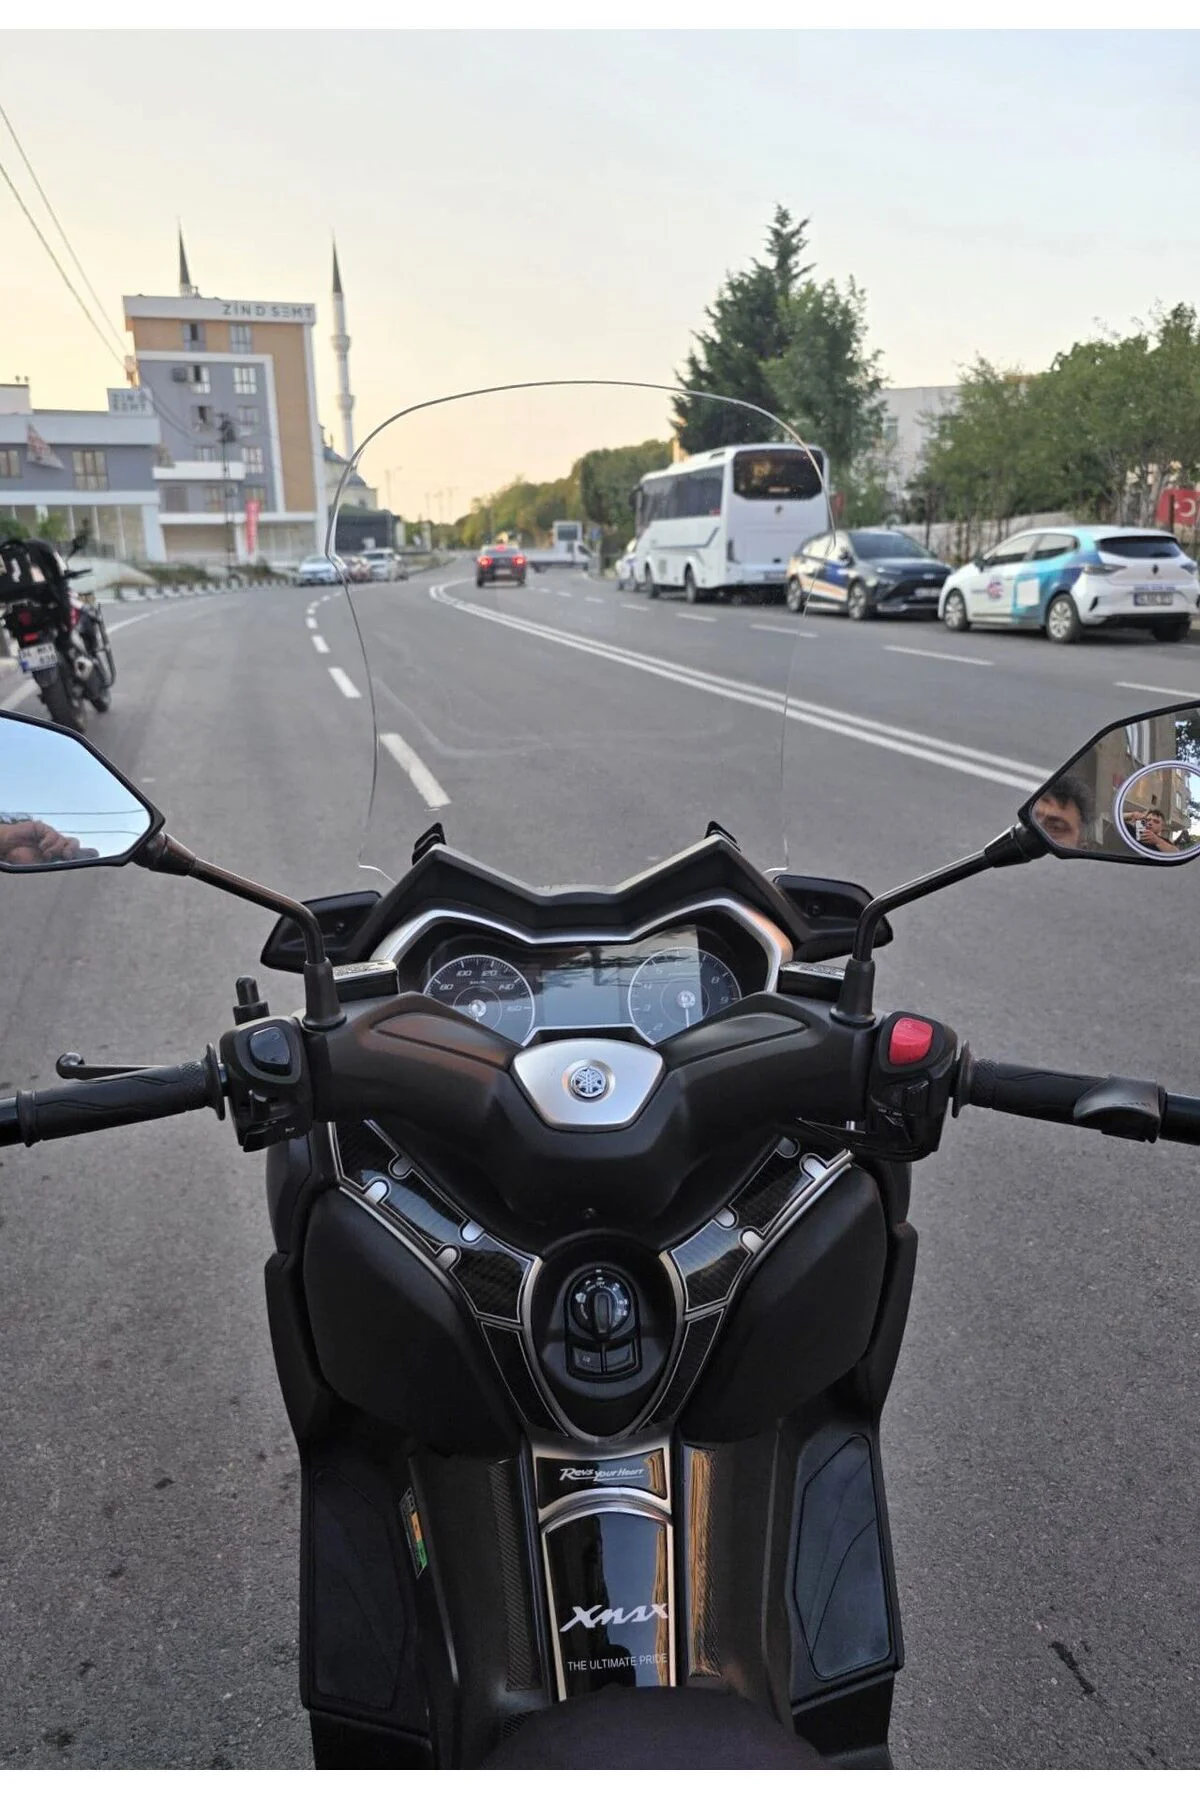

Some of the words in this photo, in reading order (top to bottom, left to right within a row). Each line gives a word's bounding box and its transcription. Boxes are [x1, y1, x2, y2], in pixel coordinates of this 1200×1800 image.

[481, 969, 498, 977] 120
[440, 983, 454, 991] 80
[499, 983, 515, 991] 140
[560, 1467, 595, 1481] Revs
[568, 1660, 587, 1671] THE
[589, 1656, 637, 1670] ULTIMATE
[639, 1653, 668, 1666] PRIDE
